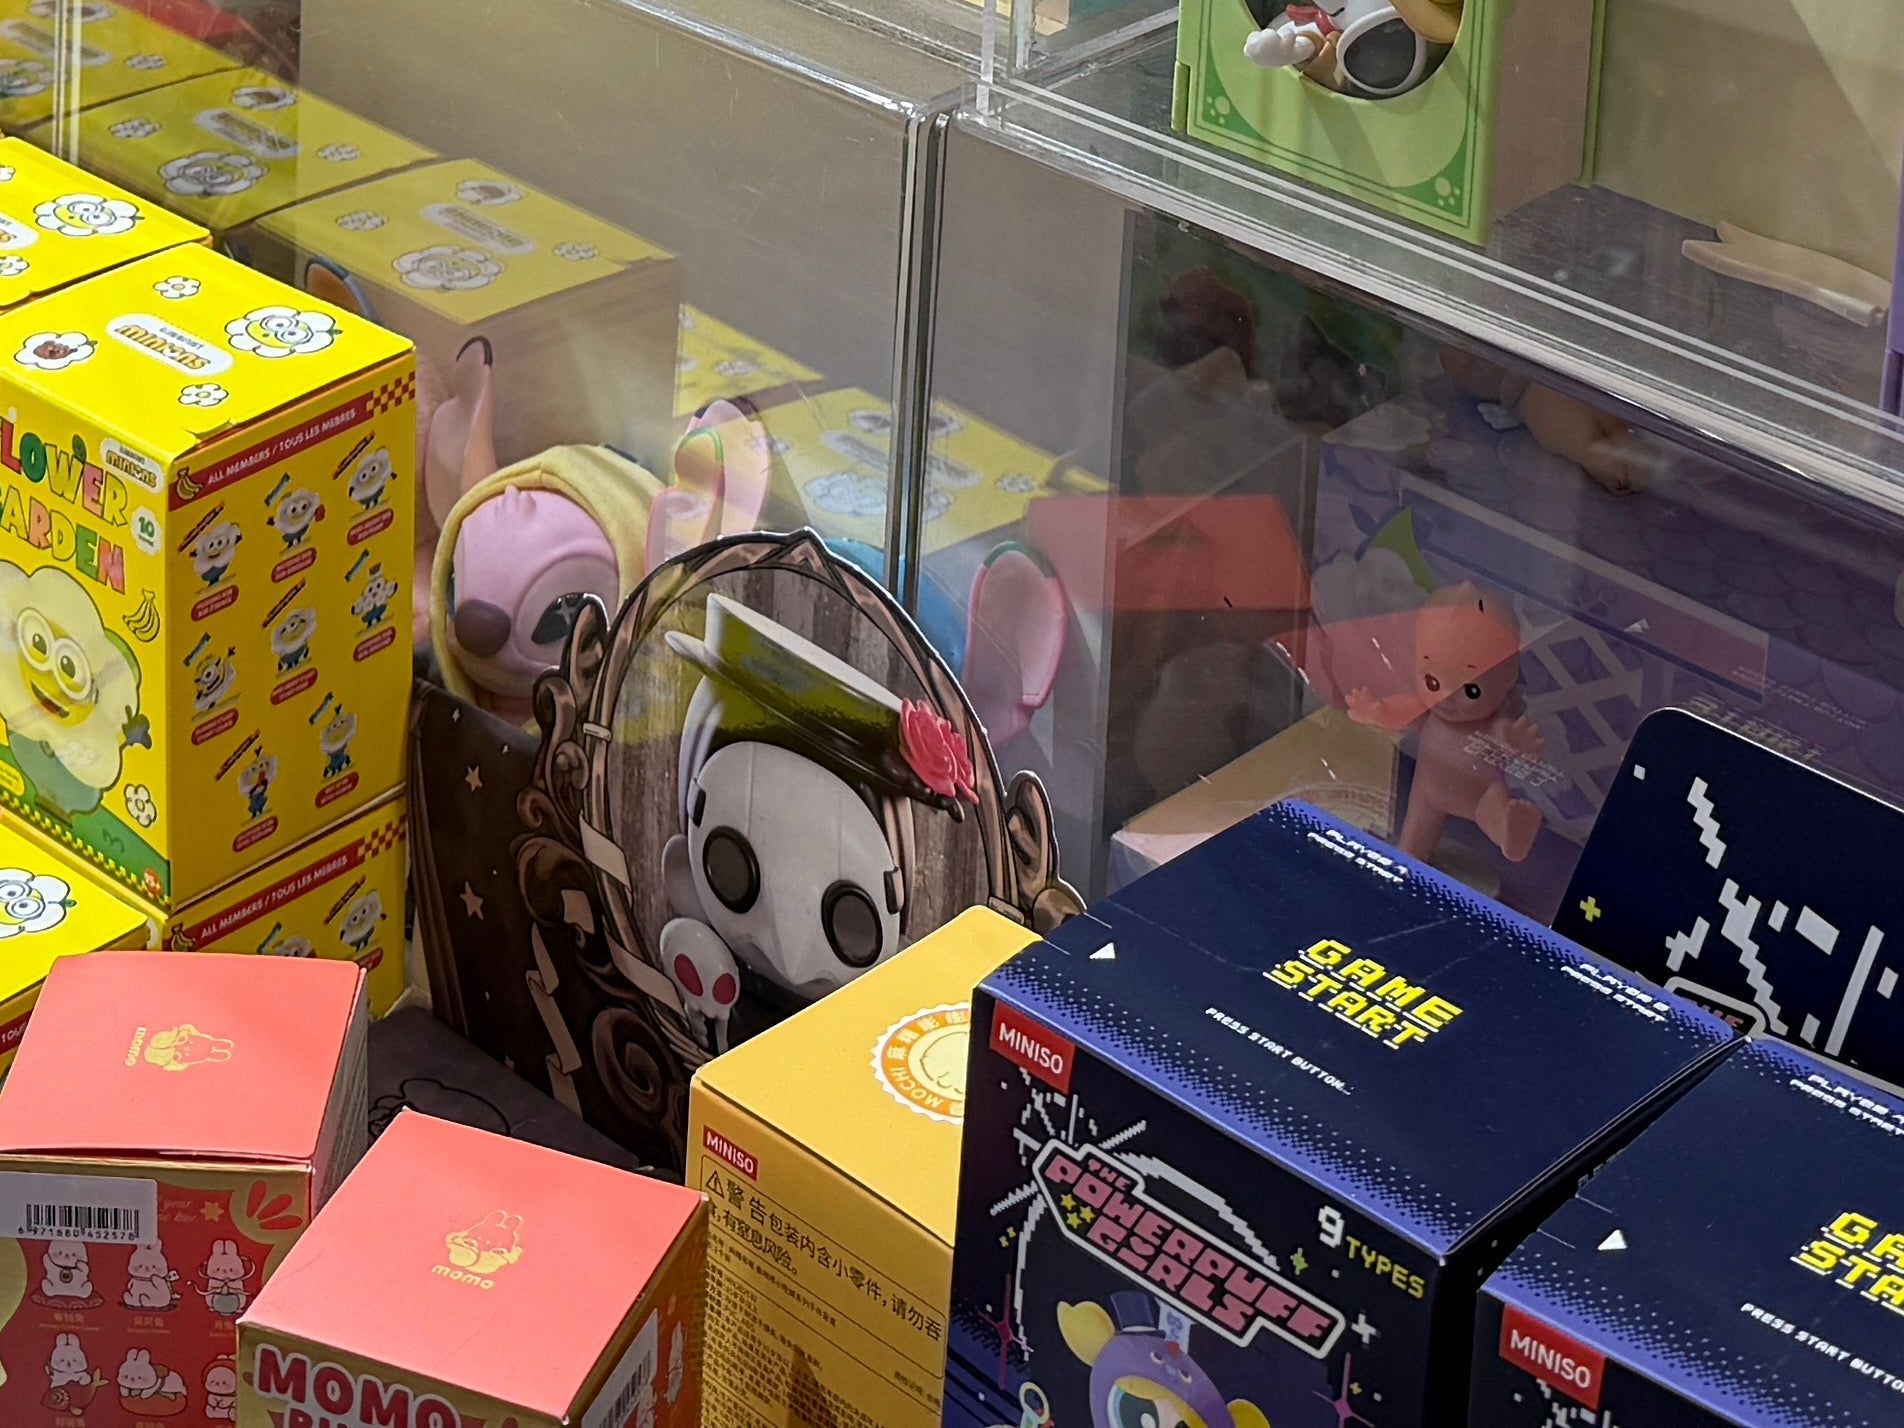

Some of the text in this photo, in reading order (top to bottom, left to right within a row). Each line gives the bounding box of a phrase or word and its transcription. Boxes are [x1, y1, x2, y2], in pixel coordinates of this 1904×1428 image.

[999, 1022, 1066, 1075] MINISO
[890, 1066, 943, 1110] MOCHI
[1089, 1156, 1132, 1192] THE
[431, 1263, 495, 1290] momo
[1044, 1154, 1333, 1340] POWERPUFF
[1087, 1215, 1255, 1332] GIRLS
[1318, 1205, 1426, 1300] 9 TYPES
[1511, 1327, 1592, 1390] MINISO
[1741, 1301, 1790, 1338] PRESS
[1796, 1329, 1848, 1365] START
[257, 1344, 461, 1428] MOMO
